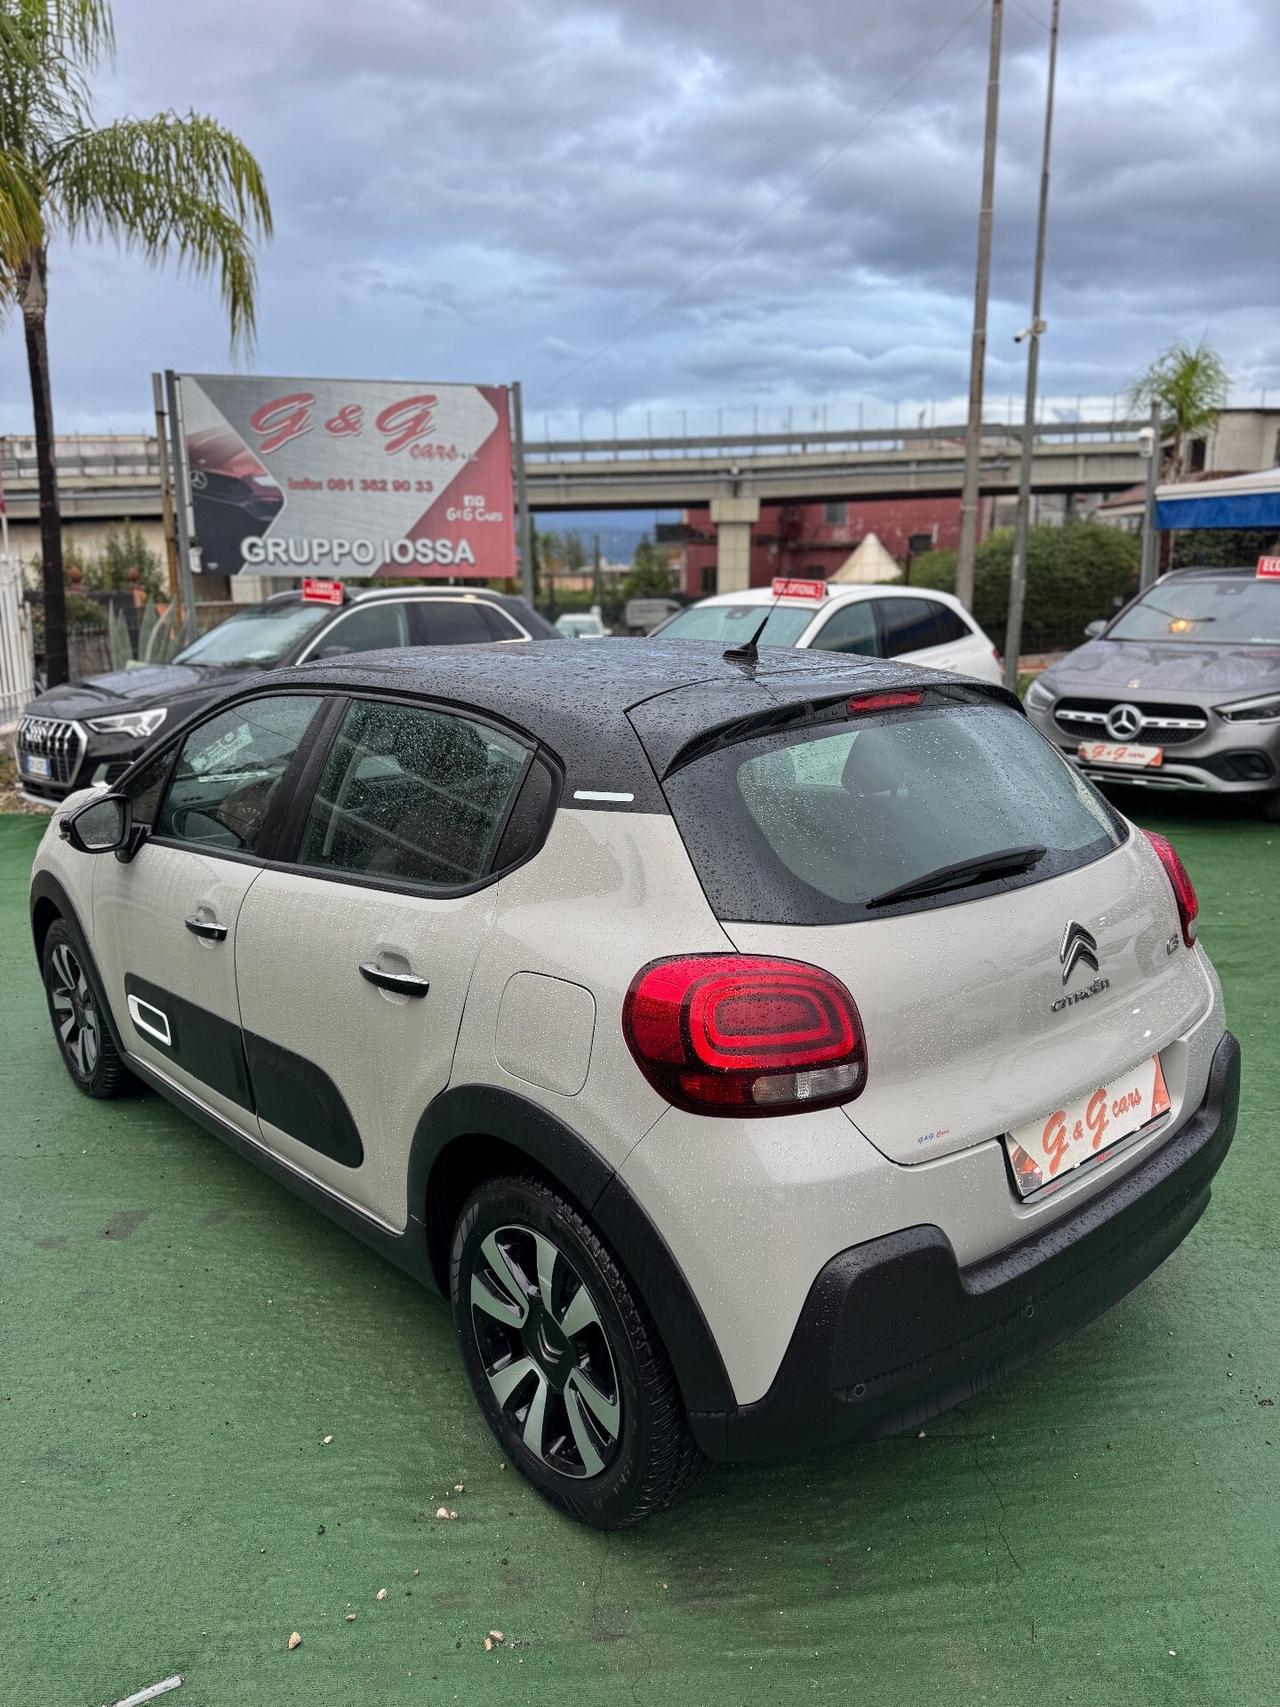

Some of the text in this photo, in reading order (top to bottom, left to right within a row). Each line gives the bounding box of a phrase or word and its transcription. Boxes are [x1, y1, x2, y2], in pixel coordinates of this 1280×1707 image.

[250, 392, 438, 455] G & G
[327, 478, 354, 491] 081
[392, 479, 411, 492] 90
[415, 480, 433, 493] 33
[241, 536, 476, 565] GRUPPO IOSSA
[1042, 1087, 1142, 1175] G & G cars
